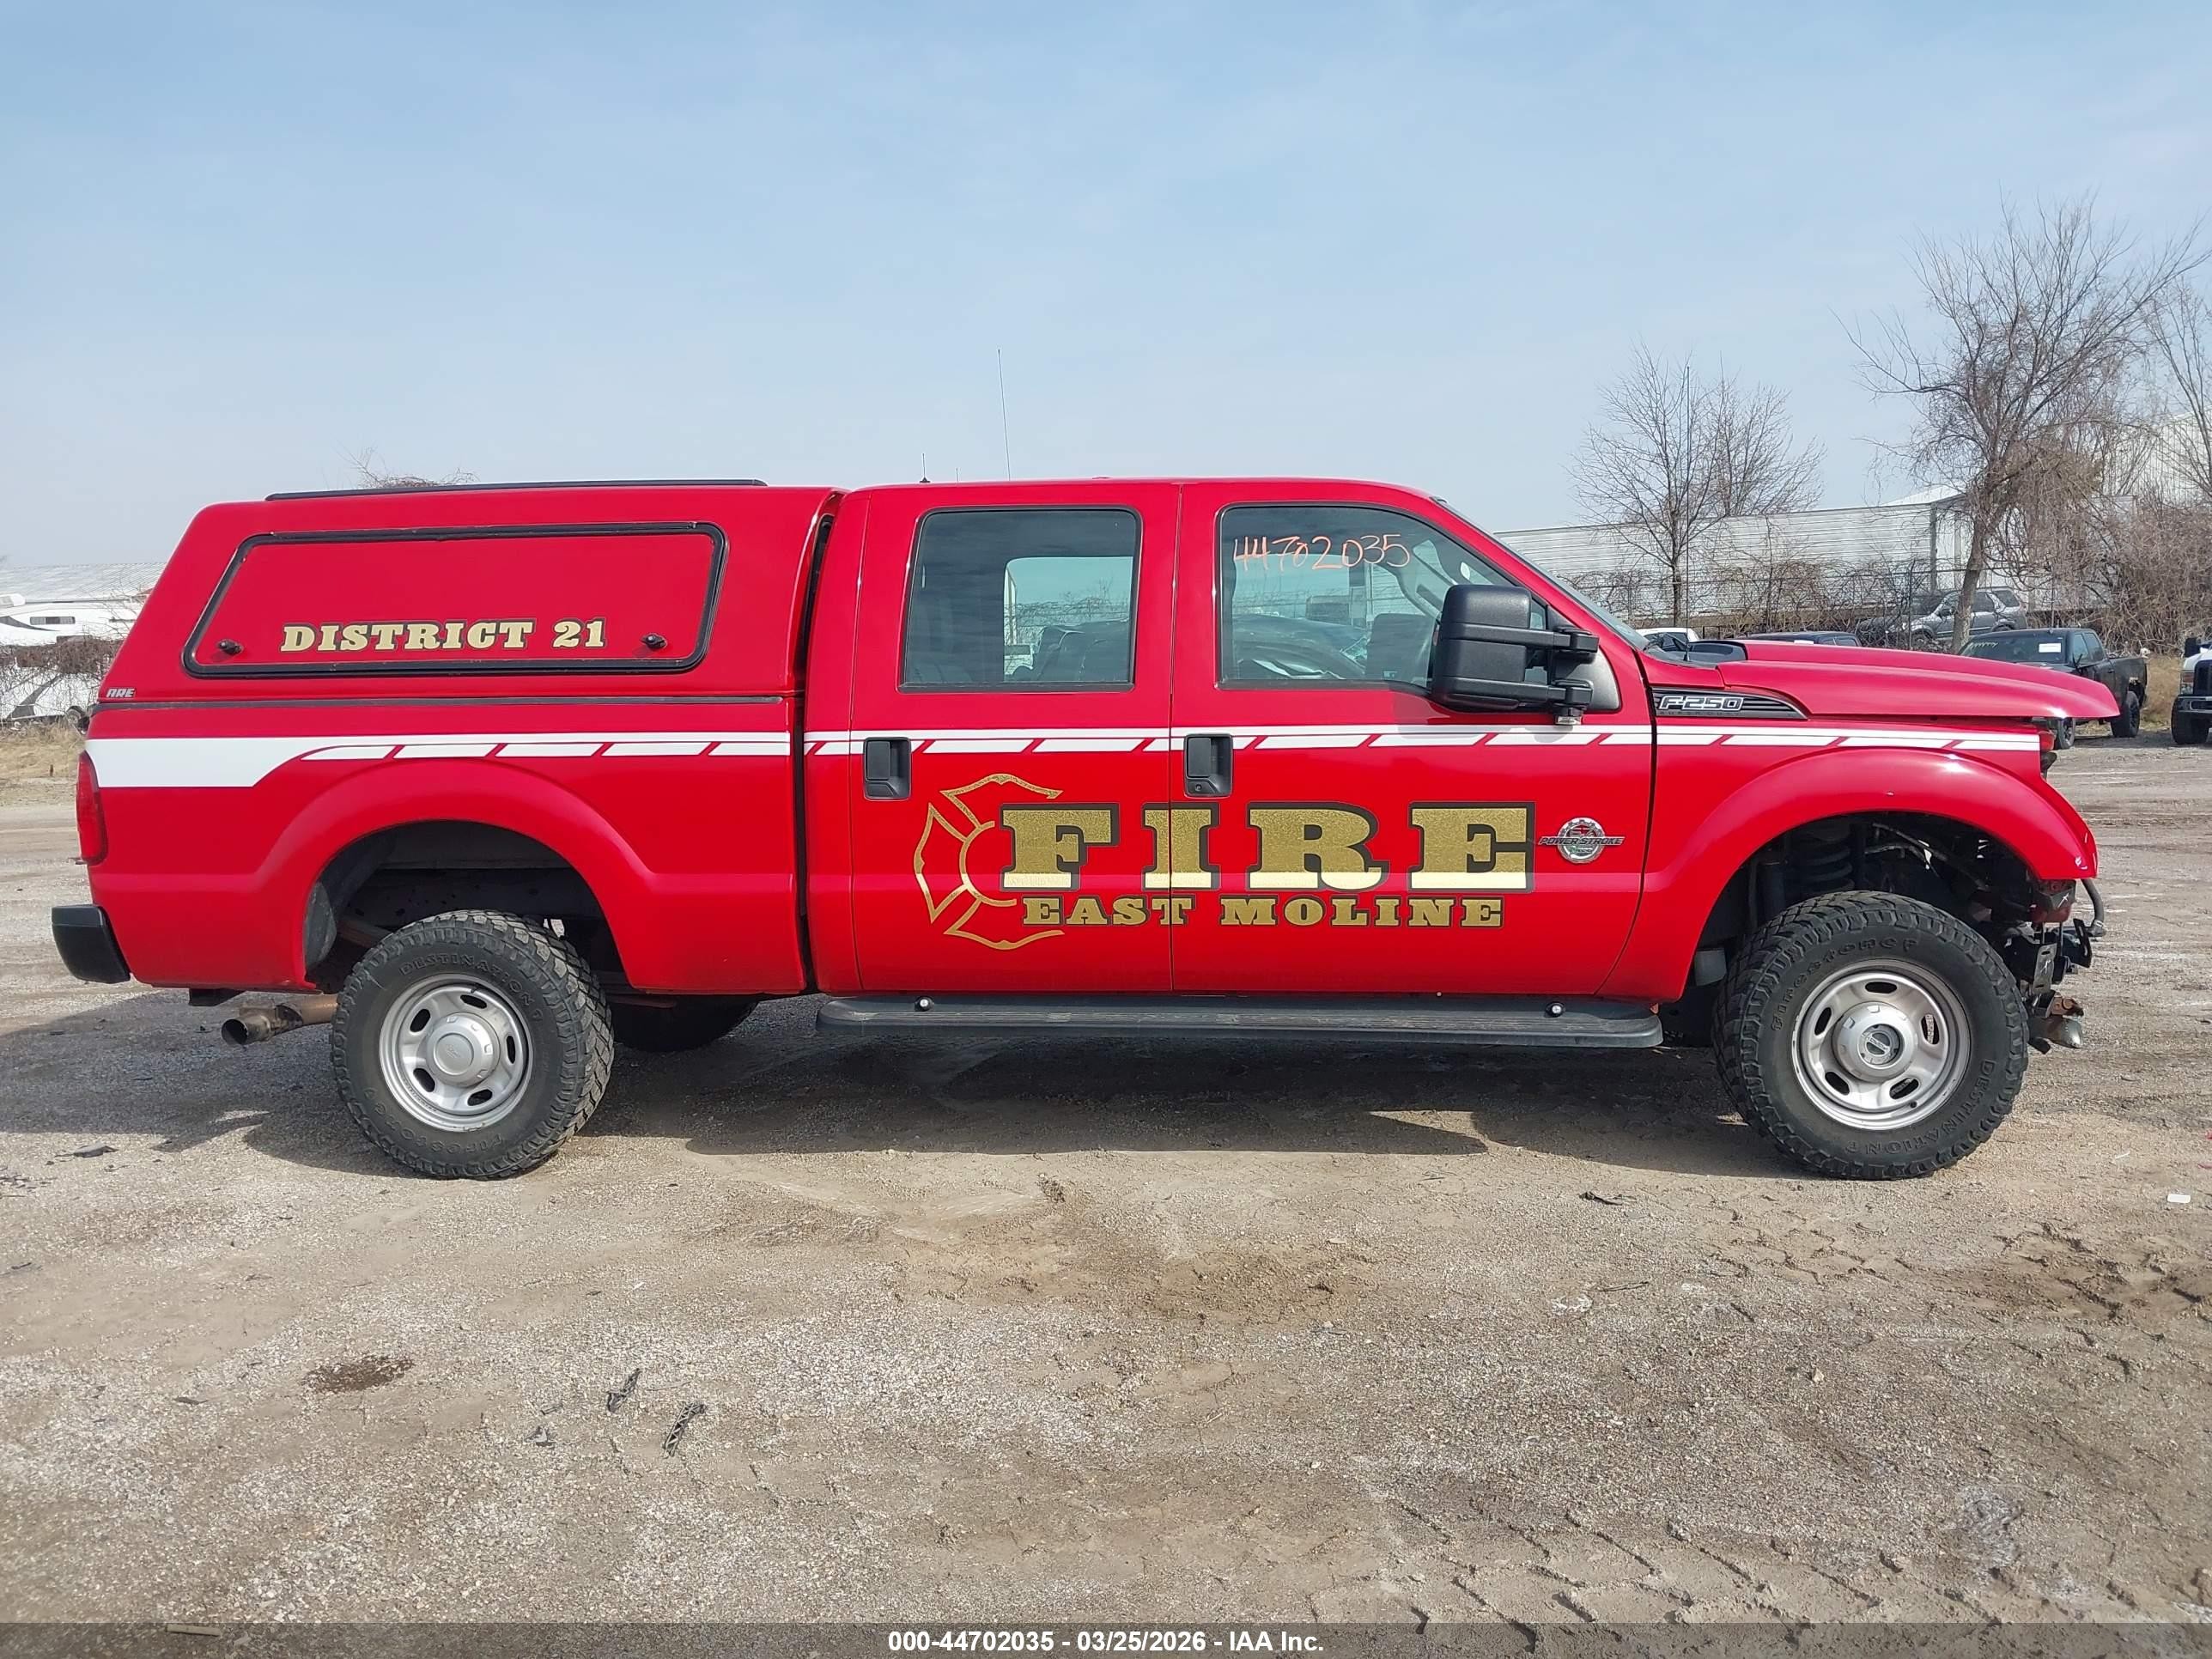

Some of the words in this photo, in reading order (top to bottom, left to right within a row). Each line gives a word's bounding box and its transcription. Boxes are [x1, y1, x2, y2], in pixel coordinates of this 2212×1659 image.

[1233, 534, 1410, 572] 44702035
[279, 619, 536, 653] DISTRICT
[552, 618, 606, 649] 21
[1659, 696, 1744, 711] F-250
[1000, 804, 1532, 891] FIRE
[1580, 836, 1624, 845] STROKE
[1021, 896, 1194, 927] EAST
[1220, 895, 1504, 927] MOLINE
[399, 953, 535, 1006] DESTINATION
[1864, 1059, 1996, 1157] DESTINATION
